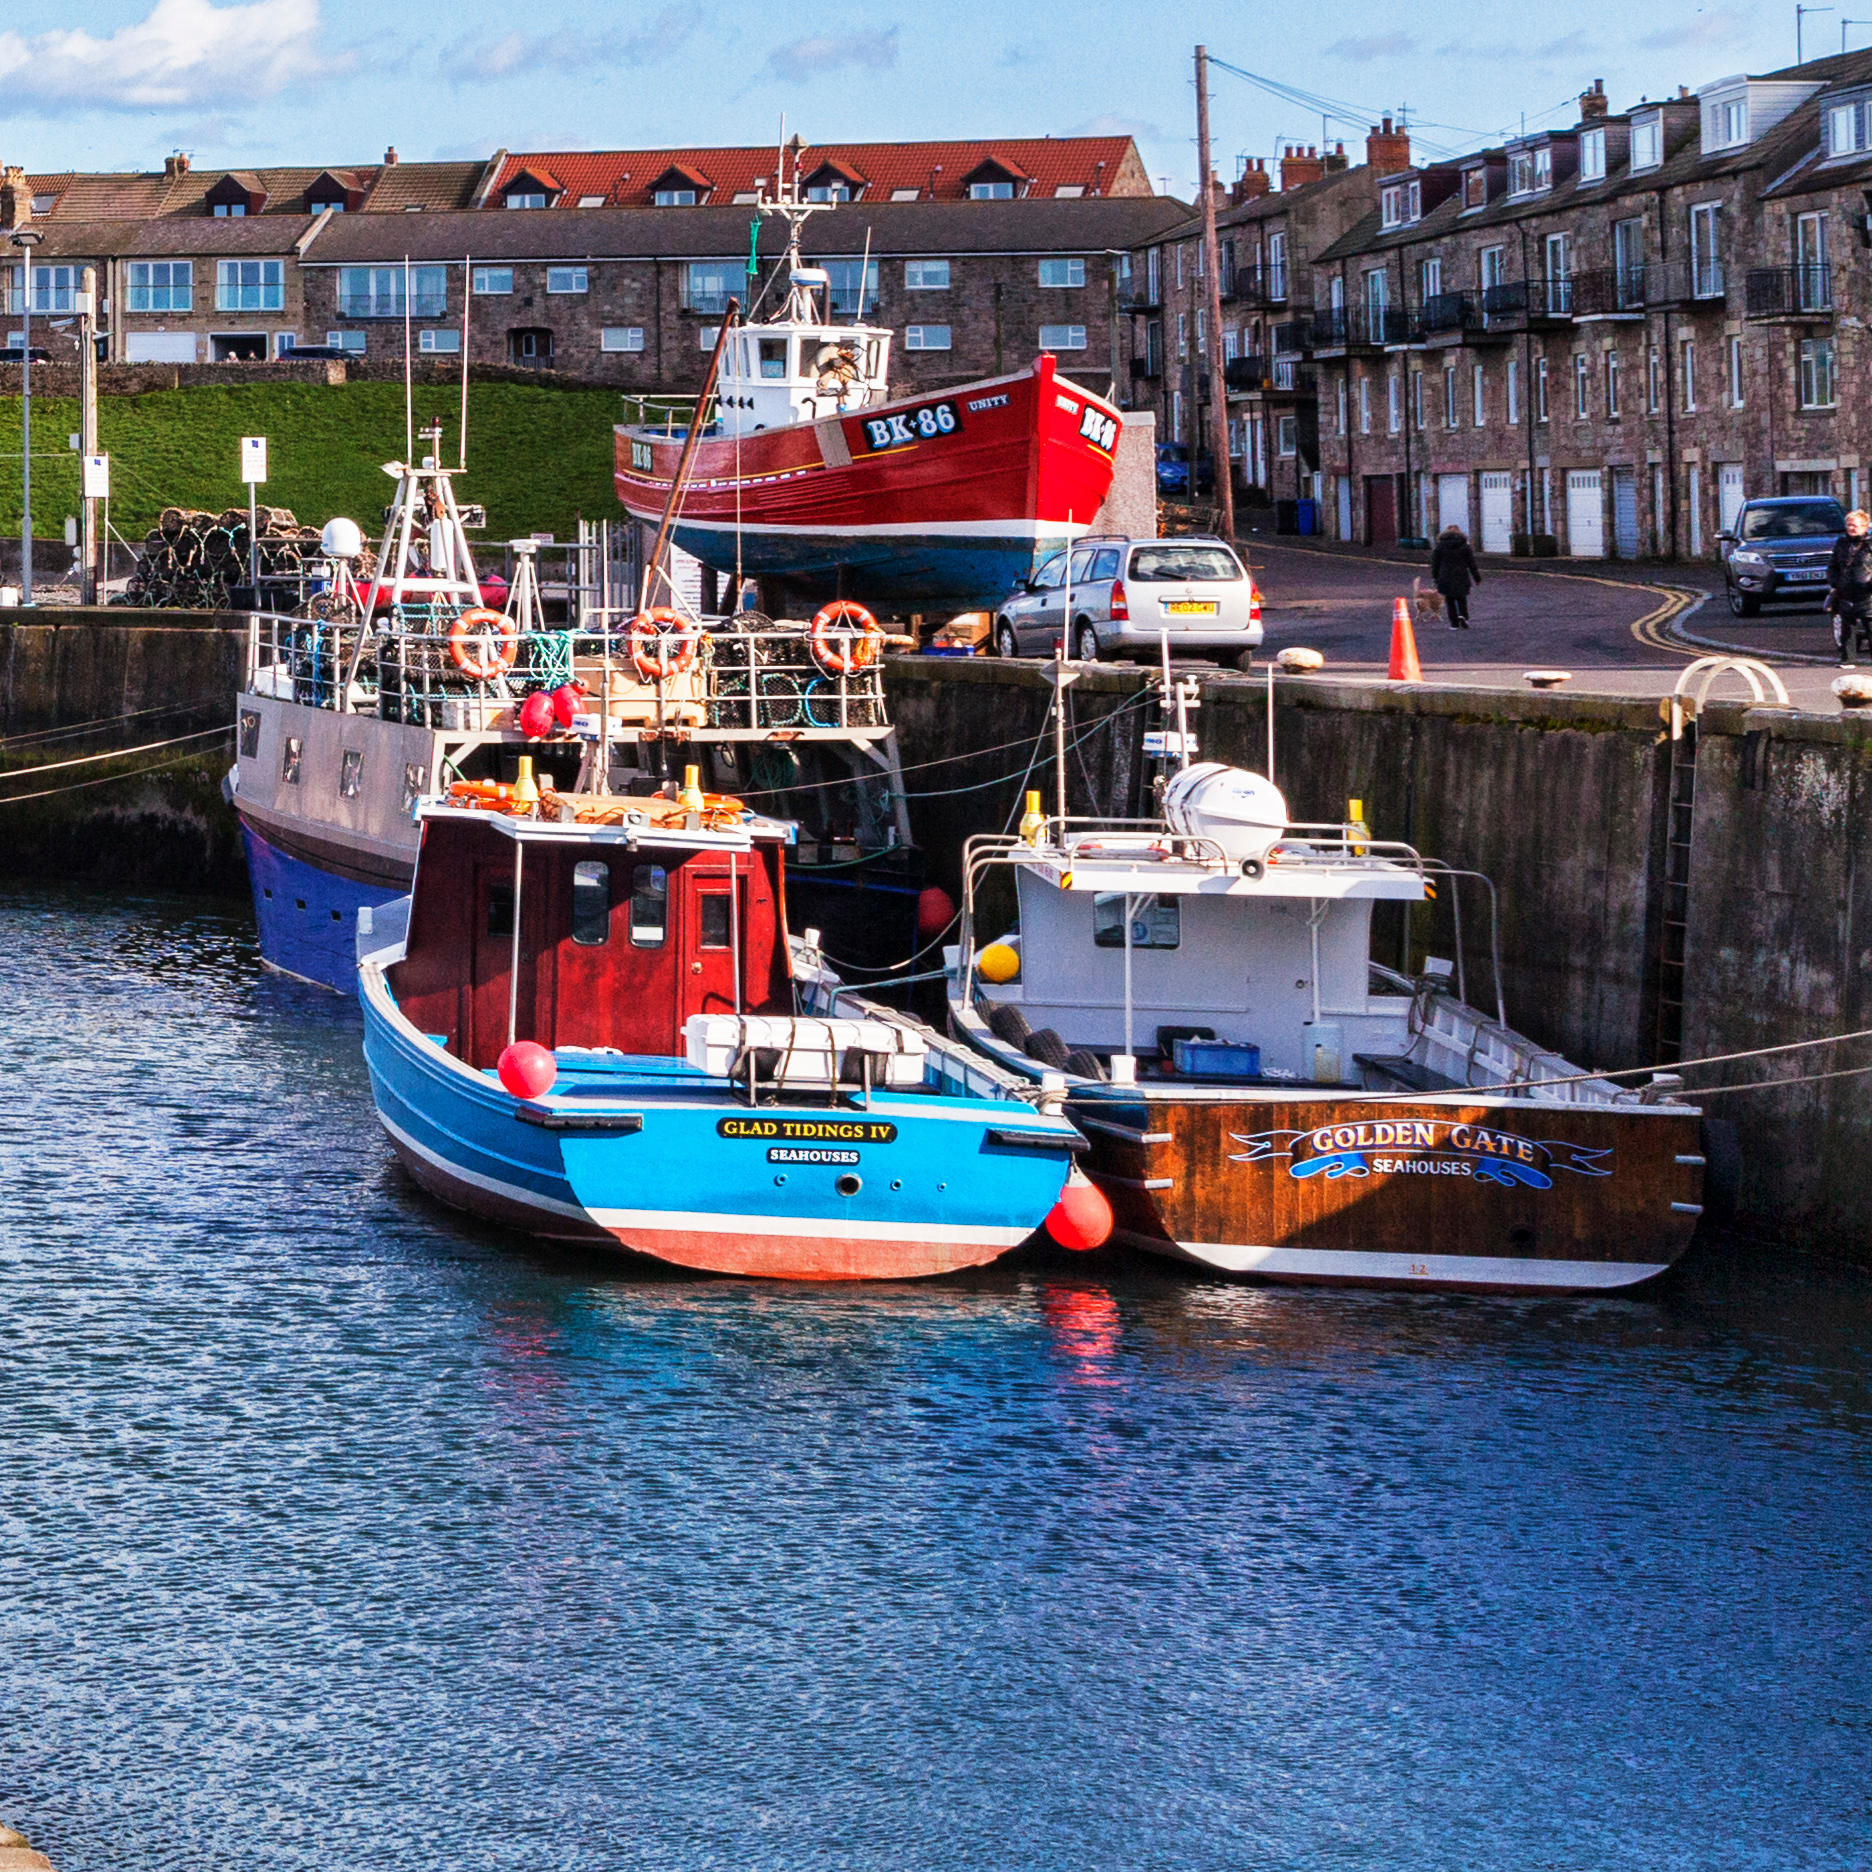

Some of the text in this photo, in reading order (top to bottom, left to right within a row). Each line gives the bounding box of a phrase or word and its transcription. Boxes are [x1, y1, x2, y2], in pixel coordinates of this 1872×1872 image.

[968, 395, 1008, 411] UNITY
[724, 1121, 891, 1139] GLAD TIDINGS IV
[1312, 1122, 1535, 1162] GOLDEN GATE
[770, 1149, 859, 1163] SEAHOUSES
[1373, 1158, 1472, 1176] SEAHOUSES
